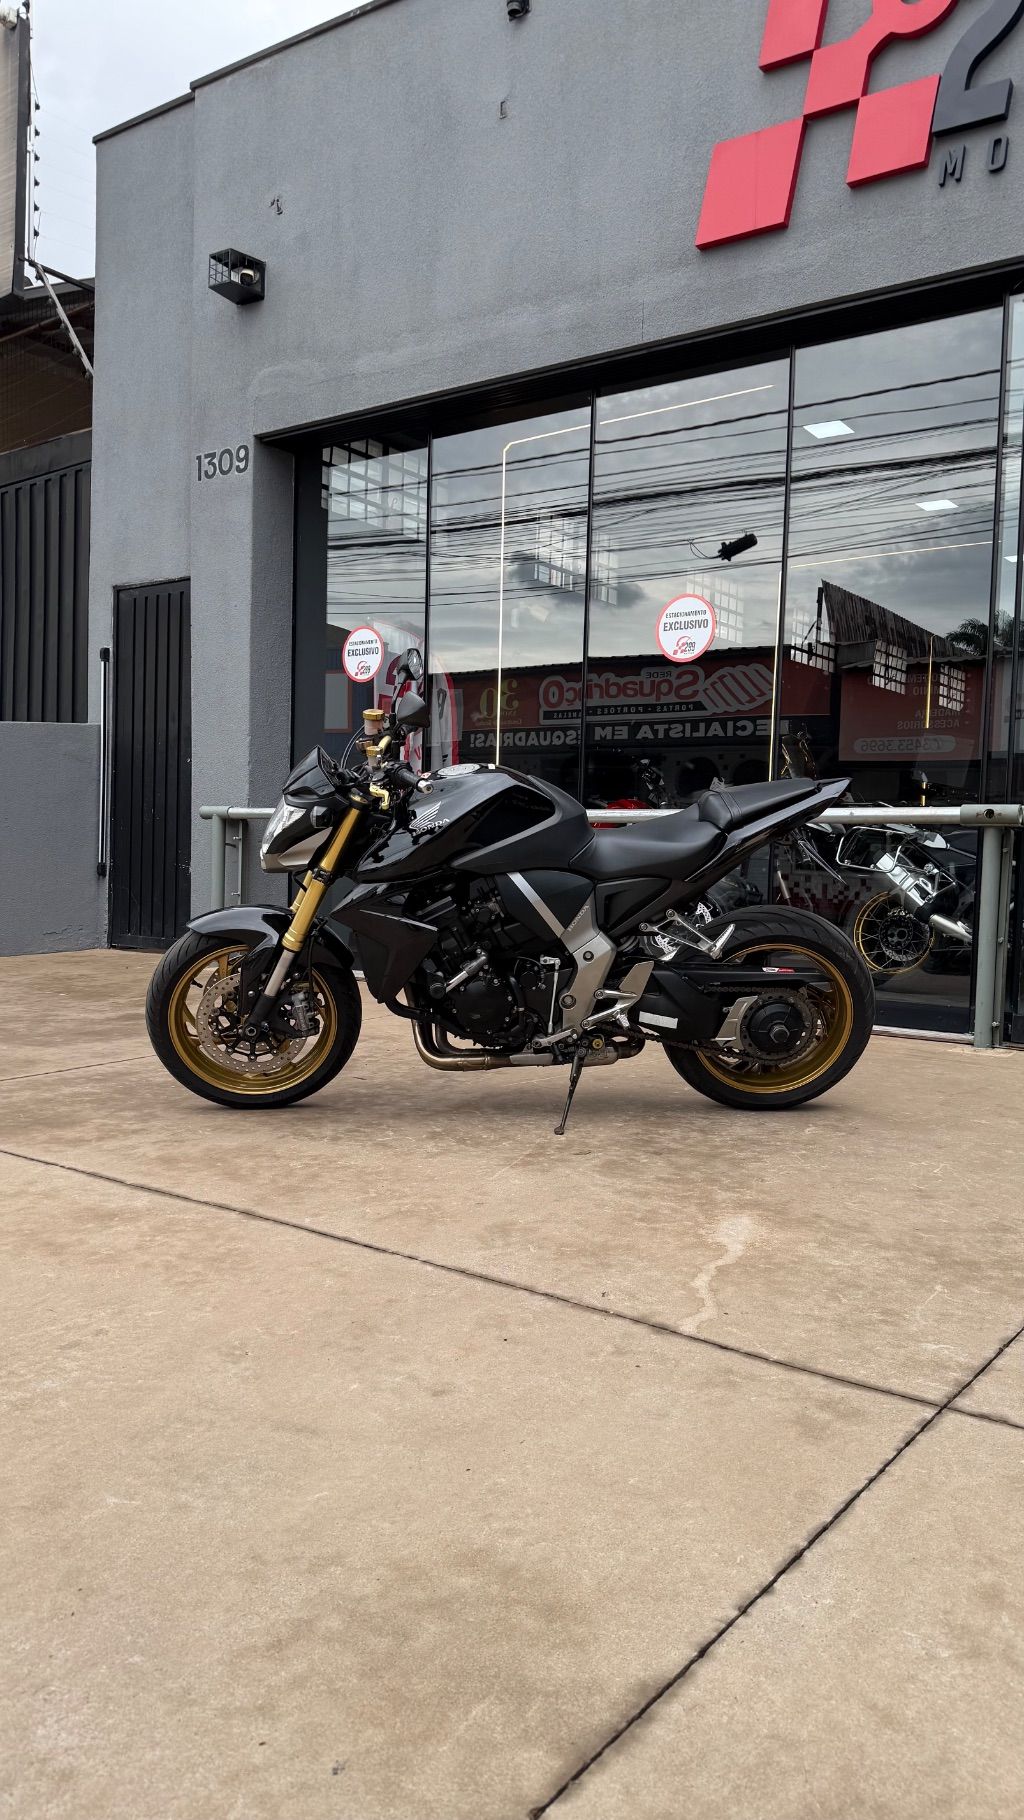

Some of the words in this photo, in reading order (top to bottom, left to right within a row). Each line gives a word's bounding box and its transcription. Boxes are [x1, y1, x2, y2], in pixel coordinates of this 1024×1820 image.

[938, 135, 1010, 188] MO
[195, 444, 250, 481] 1309
[665, 609, 707, 619] ESTACIONAMENTO
[663, 618, 709, 632] EXCLUSIVO
[347, 646, 379, 657] EXCLUSIVO
